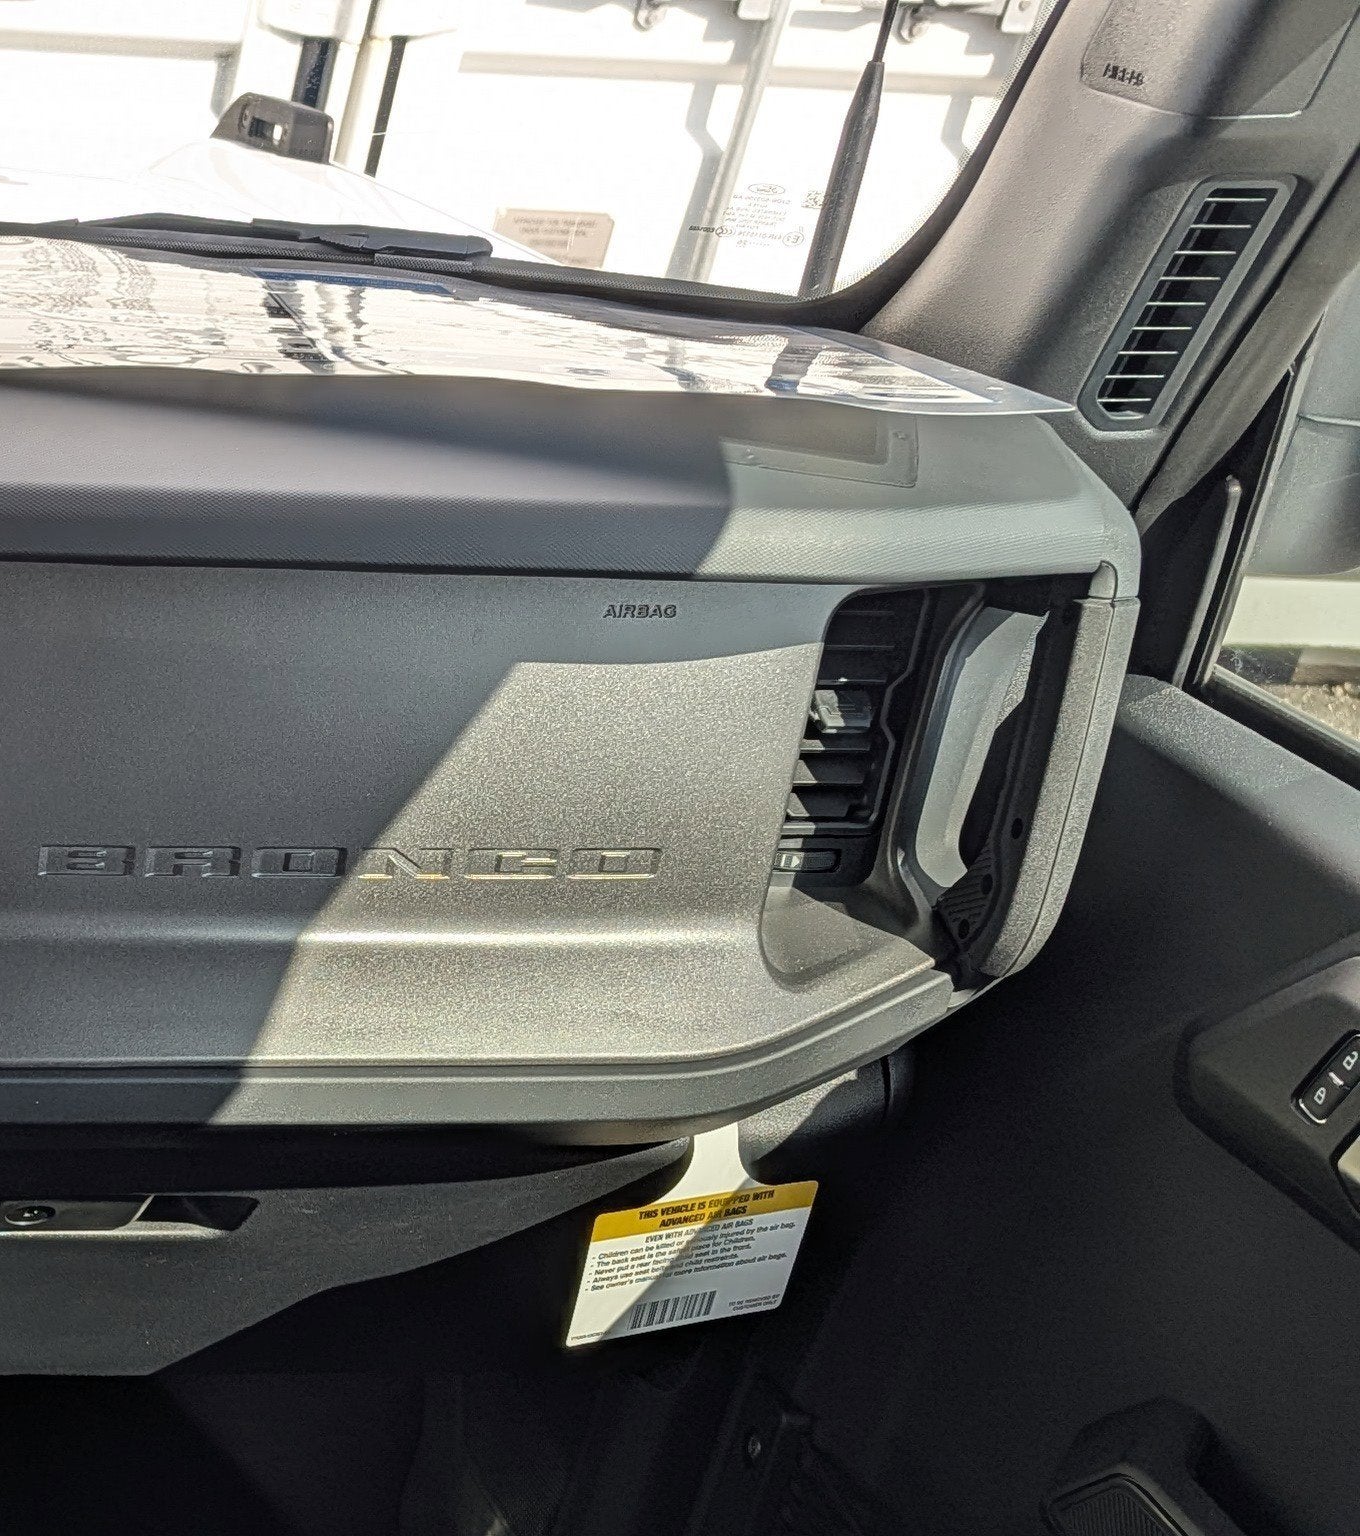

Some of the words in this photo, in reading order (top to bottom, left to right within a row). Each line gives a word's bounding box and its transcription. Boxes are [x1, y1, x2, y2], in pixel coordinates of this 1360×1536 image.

[602, 603, 678, 620] AIRBAG
[37, 844, 662, 881] BRONCO
[638, 1208, 659, 1220] THIS
[660, 1202, 696, 1217] VEHICLE
[697, 1201, 707, 1210] IS
[708, 1193, 750, 1208] EQUIPPED
[752, 1189, 775, 1202] WITH
[659, 1212, 706, 1228] ADVANCED
[707, 1209, 722, 1220] AIR
[723, 1205, 748, 1217] BAGS
[598, 1249, 629, 1260] Children
[630, 1246, 643, 1254] can
[718, 1229, 745, 1240] injured
[746, 1227, 756, 1236] by
[756, 1225, 768, 1233] the
[769, 1223, 780, 1231] air
[780, 1221, 796, 1231] bag.
[645, 1233, 663, 1243] EVEN
[664, 1230, 683, 1240] WITH
[721, 1221, 734, 1230] AIR
[734, 1218, 754, 1228] BAGS
[594, 1266, 616, 1276] Never
[616, 1264, 629, 1273] put
[636, 1261, 651, 1269] rear
[719, 1246, 731, 1254] the
[596, 1260, 610, 1268] The
[611, 1256, 629, 1266] back
[655, 1249, 667, 1258] the
[723, 1235, 756, 1245] Children.
[590, 1283, 605, 1292] See
[693, 1261, 734, 1273] information
[735, 1256, 757, 1266] about
[592, 1274, 618, 1284] Always
